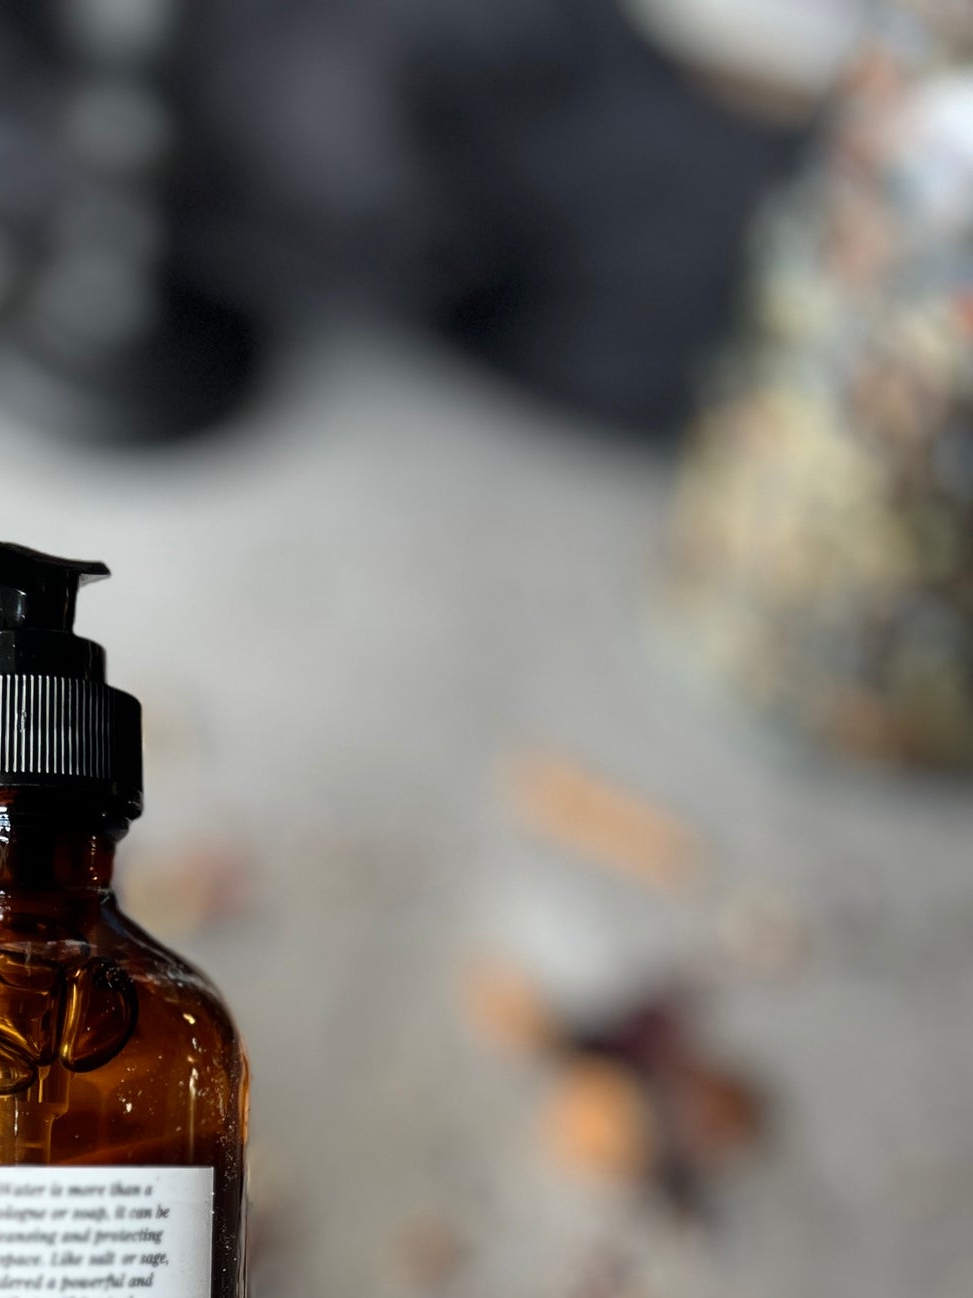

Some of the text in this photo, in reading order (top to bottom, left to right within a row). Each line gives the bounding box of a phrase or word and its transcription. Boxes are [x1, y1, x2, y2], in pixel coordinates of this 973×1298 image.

[49, 1181, 63, 1197] is
[68, 1184, 105, 1197] more
[109, 1181, 141, 1197] than
[143, 1184, 153, 1196] a
[50, 1208, 67, 1219] or
[129, 1207, 153, 1219] can
[155, 1203, 170, 1219] be
[61, 1228, 92, 1243] and
[93, 1227, 164, 1246] protecting
[49, 1251, 83, 1267] Like
[88, 1251, 116, 1266] salt
[121, 1254, 137, 1266] or
[139, 1252, 169, 1268] sage,
[47, 1278, 56, 1290] a
[60, 1273, 125, 1292] powerful
[128, 1272, 154, 1289] and
